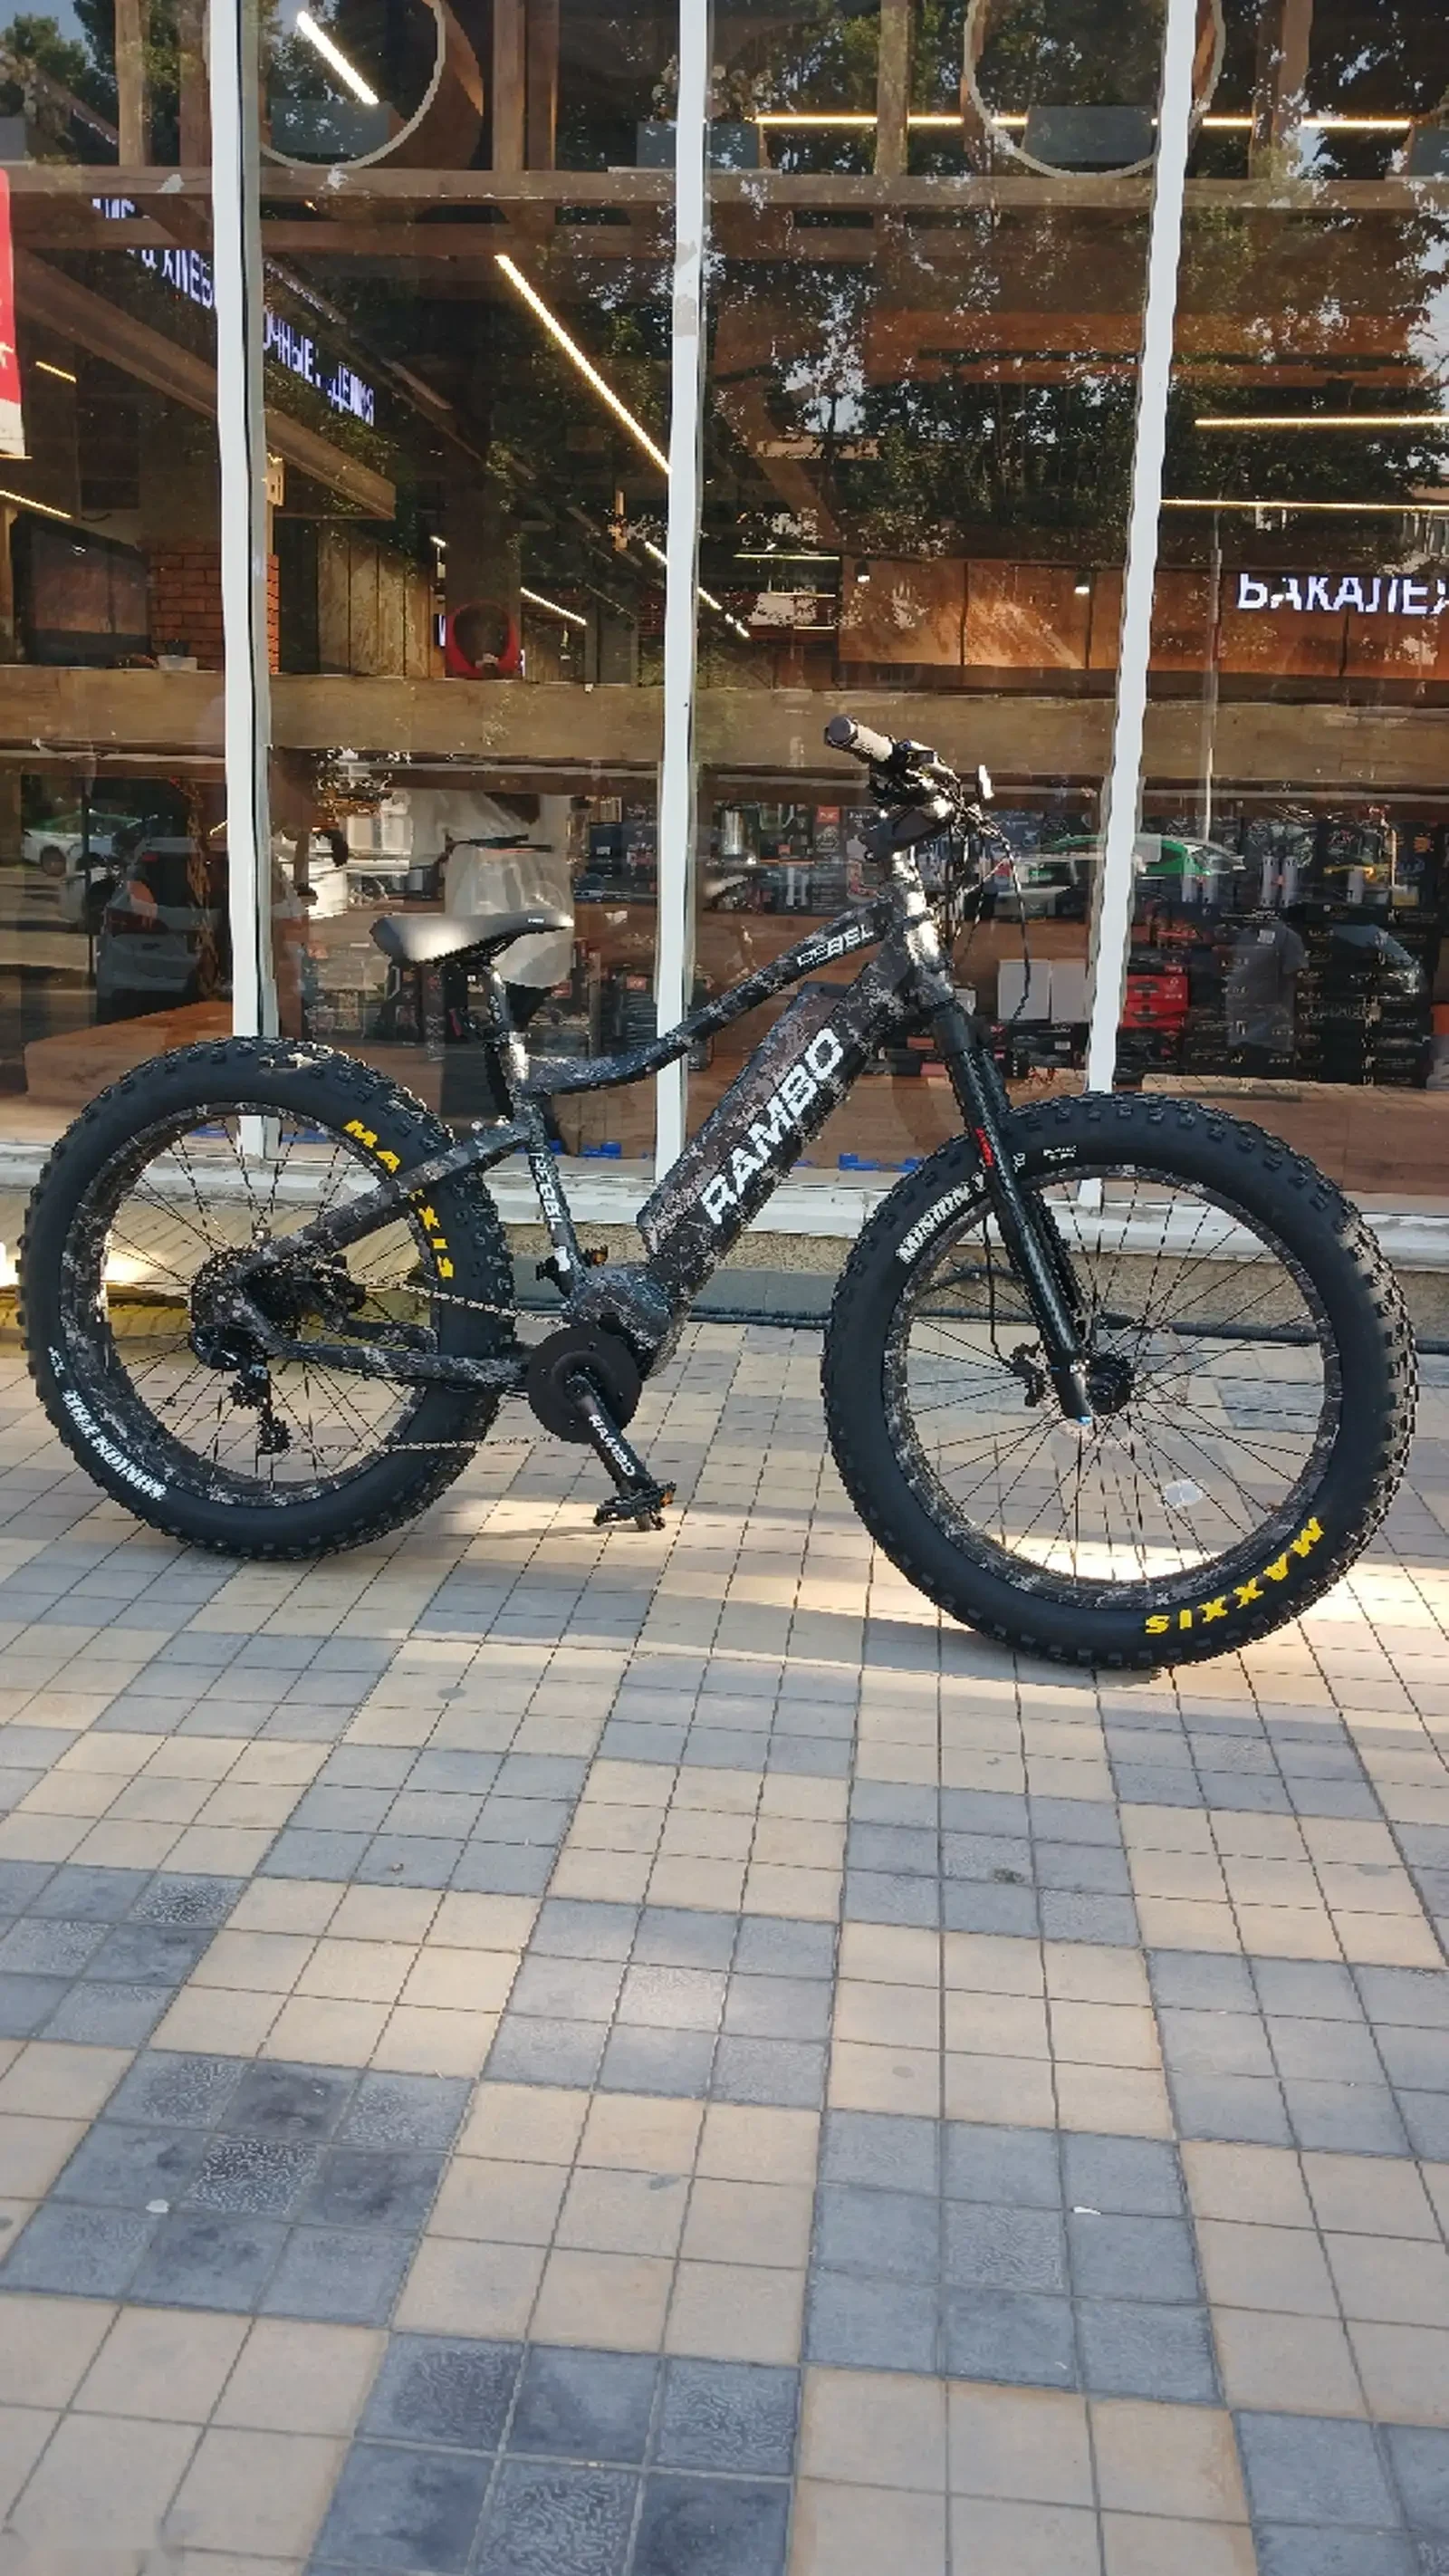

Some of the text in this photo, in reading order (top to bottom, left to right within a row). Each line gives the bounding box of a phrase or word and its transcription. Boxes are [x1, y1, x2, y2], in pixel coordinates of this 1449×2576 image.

[701, 1027, 844, 1224] RAMBO
[343, 1120, 454, 1278] MAXIS
[529, 1153, 562, 1231] REBEL
[589, 1413, 636, 1477] RAMBO
[1145, 1516, 1324, 1634] MAXXIS
